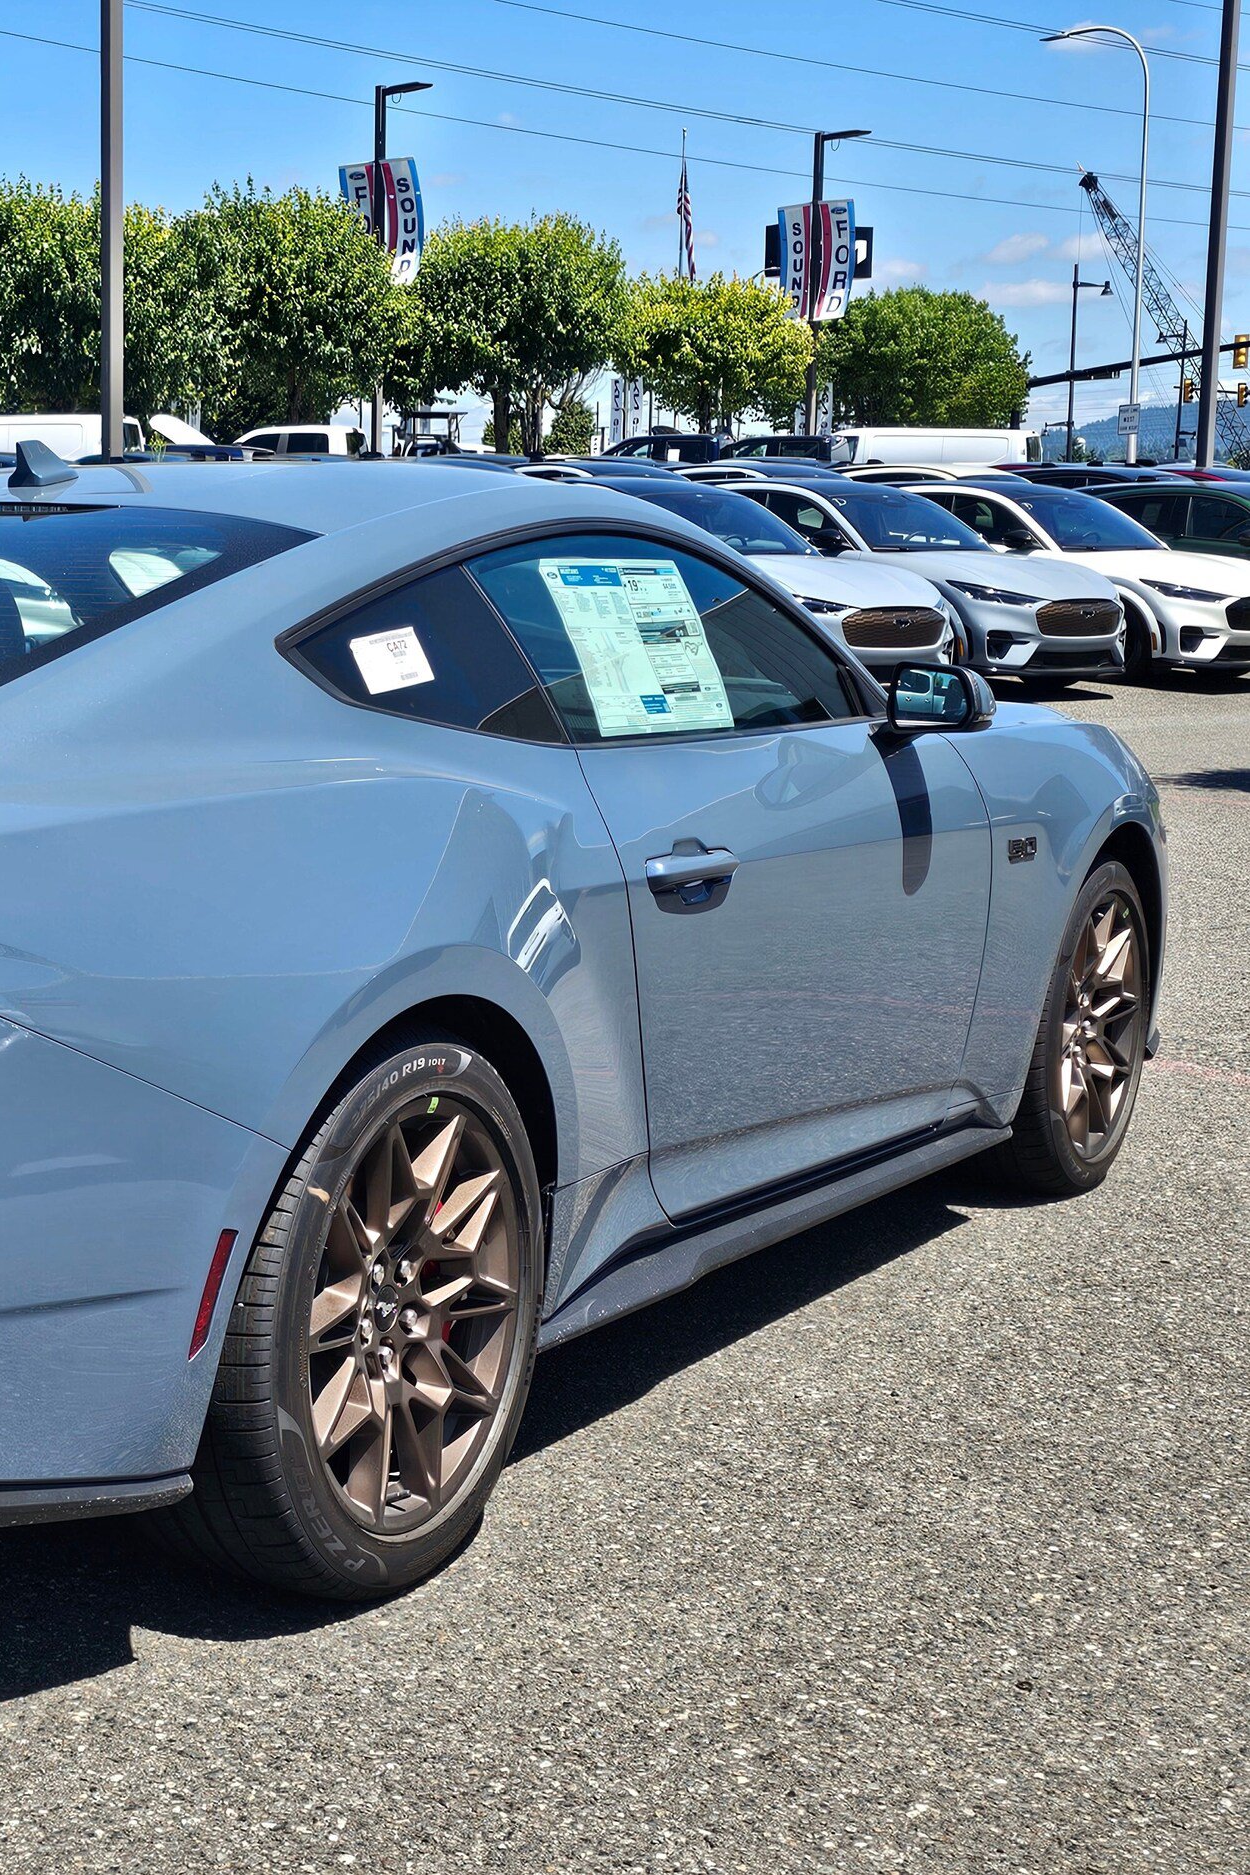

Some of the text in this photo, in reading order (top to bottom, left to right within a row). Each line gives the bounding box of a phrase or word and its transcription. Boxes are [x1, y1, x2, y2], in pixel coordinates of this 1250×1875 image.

[396, 177, 416, 272] SOUND
[826, 220, 849, 312] FORD
[402, 1057, 426, 1077] R19
